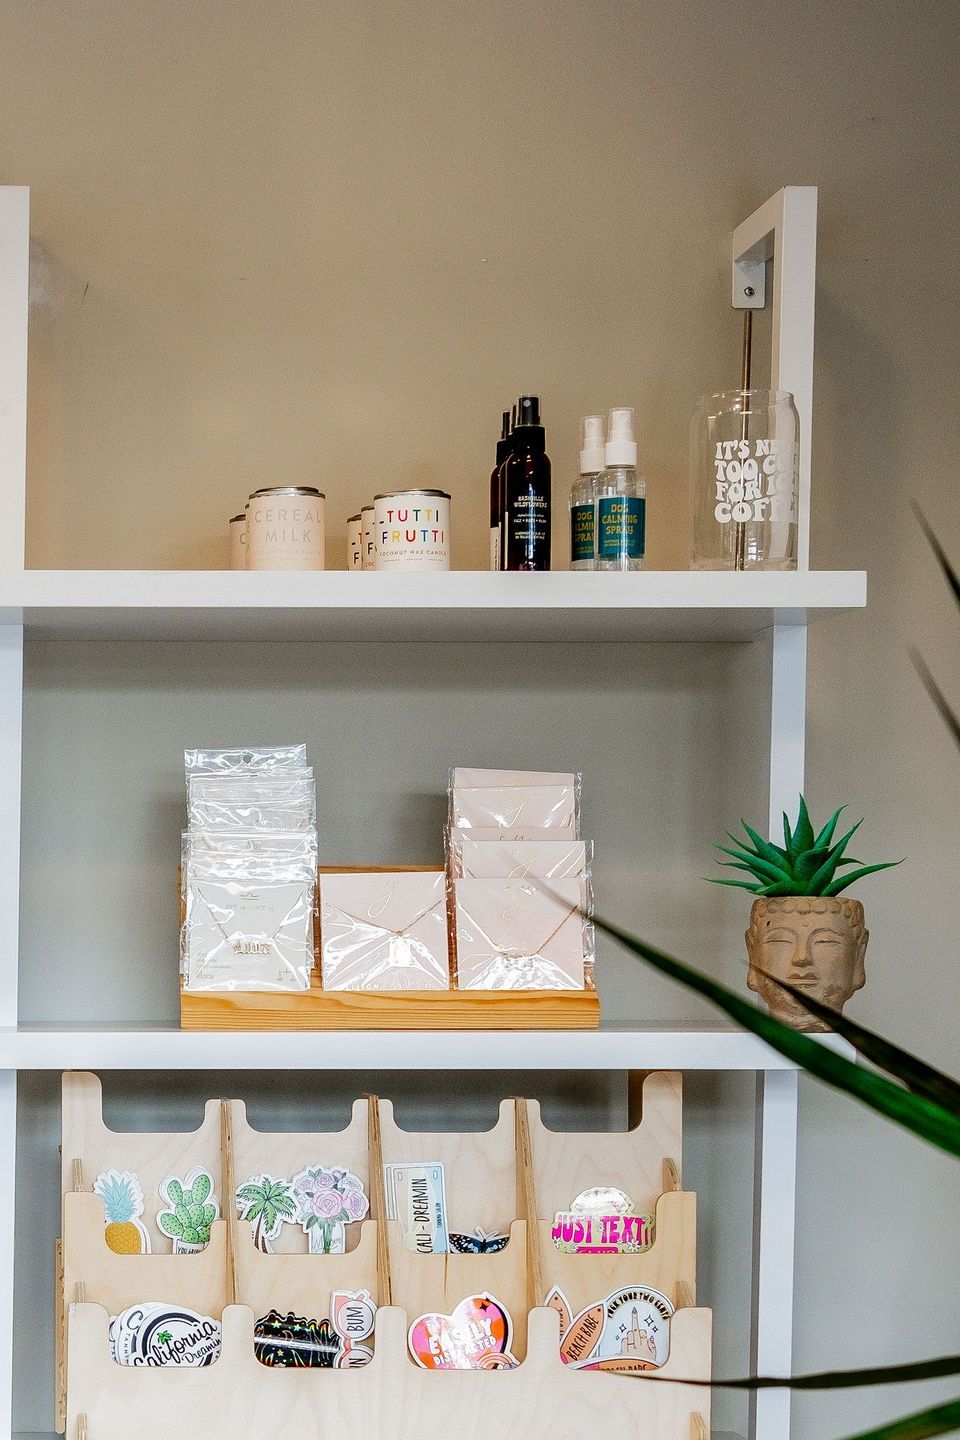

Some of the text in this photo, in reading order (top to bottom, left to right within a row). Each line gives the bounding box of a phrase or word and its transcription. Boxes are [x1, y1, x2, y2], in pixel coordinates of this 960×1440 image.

[715, 439, 750, 460] IT'S
[714, 459, 758, 482] TOO
[715, 480, 762, 503] FOR
[254, 508, 321, 523] CEREAL
[576, 511, 593, 521] DOG
[601, 514, 638, 524] CALMING
[610, 504, 629, 513] DOG
[265, 528, 312, 543] MILK
[382, 529, 444, 544] FRUTTI
[605, 525, 634, 535] SPRAY
[411, 1178, 430, 1223] DREAMIN
[551, 1215, 645, 1246] JUST TEXT
[415, 1233, 434, 1254] CALI
[617, 1291, 638, 1304] YOUR
[639, 1292, 656, 1304] TWO
[653, 1300, 671, 1321] CENTS
[346, 1306, 365, 1332] BUM
[566, 1314, 600, 1361] BEACH BABE
